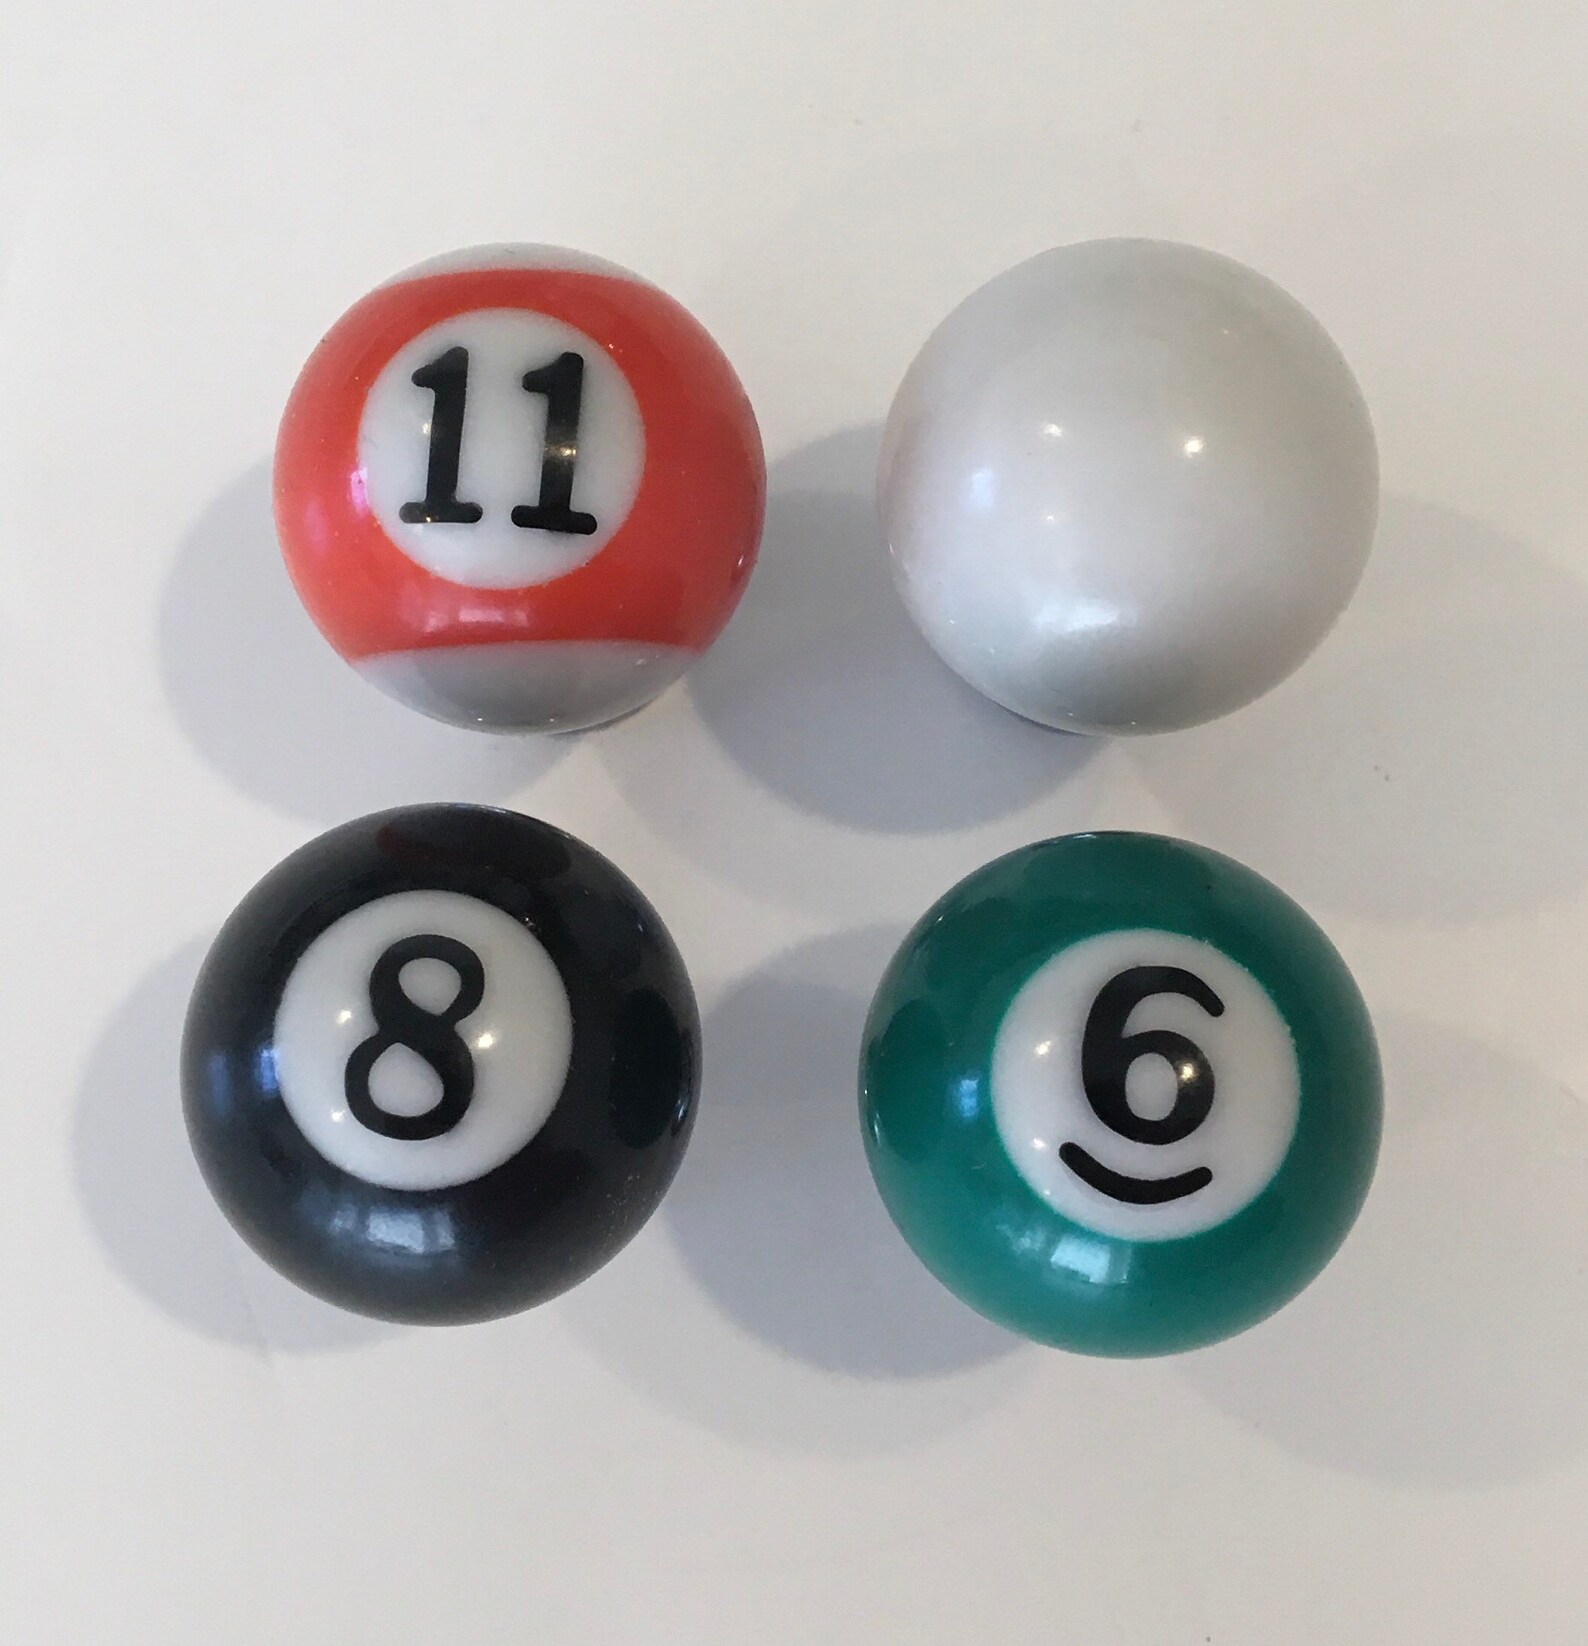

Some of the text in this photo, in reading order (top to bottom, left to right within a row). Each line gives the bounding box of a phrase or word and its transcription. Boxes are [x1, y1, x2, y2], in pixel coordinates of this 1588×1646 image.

[400, 345, 598, 536] 11
[344, 933, 487, 1141] 8
[1080, 965, 1227, 1146] 6
